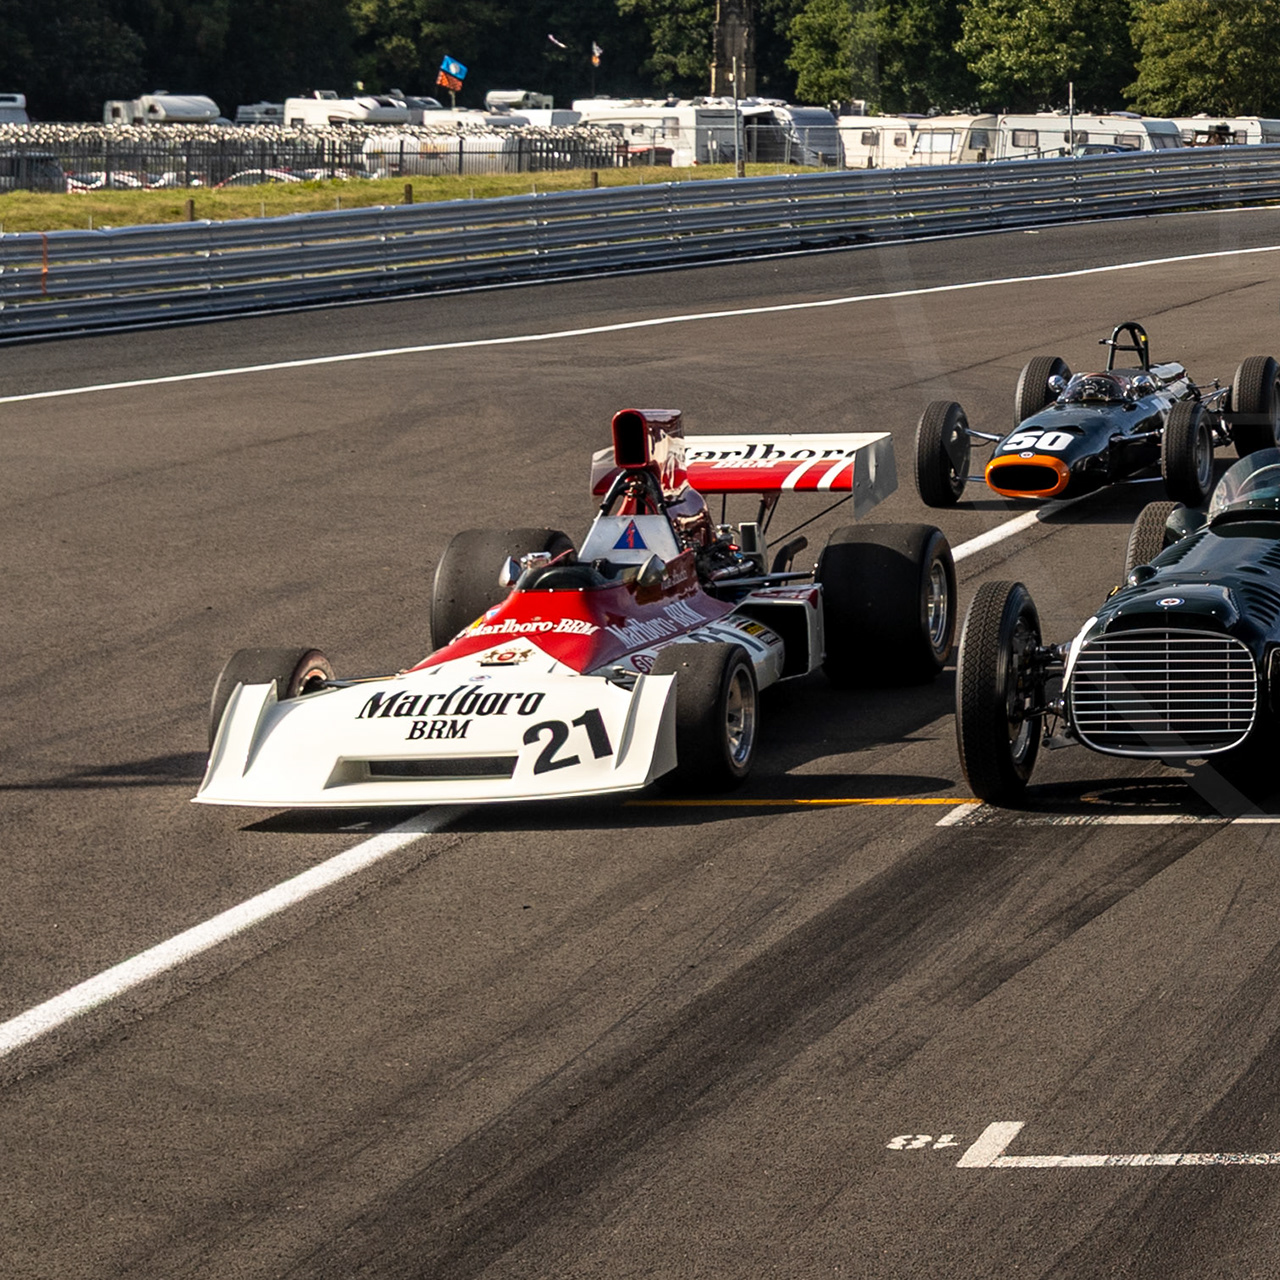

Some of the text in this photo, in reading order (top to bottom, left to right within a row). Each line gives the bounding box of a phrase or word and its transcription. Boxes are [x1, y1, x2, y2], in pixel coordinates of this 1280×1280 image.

[1002, 431, 1075, 451] 50
[685, 443, 856, 461] arlbor
[355, 685, 546, 719] Marlboro
[405, 719, 473, 740] BRM
[522, 708, 613, 776] 21
